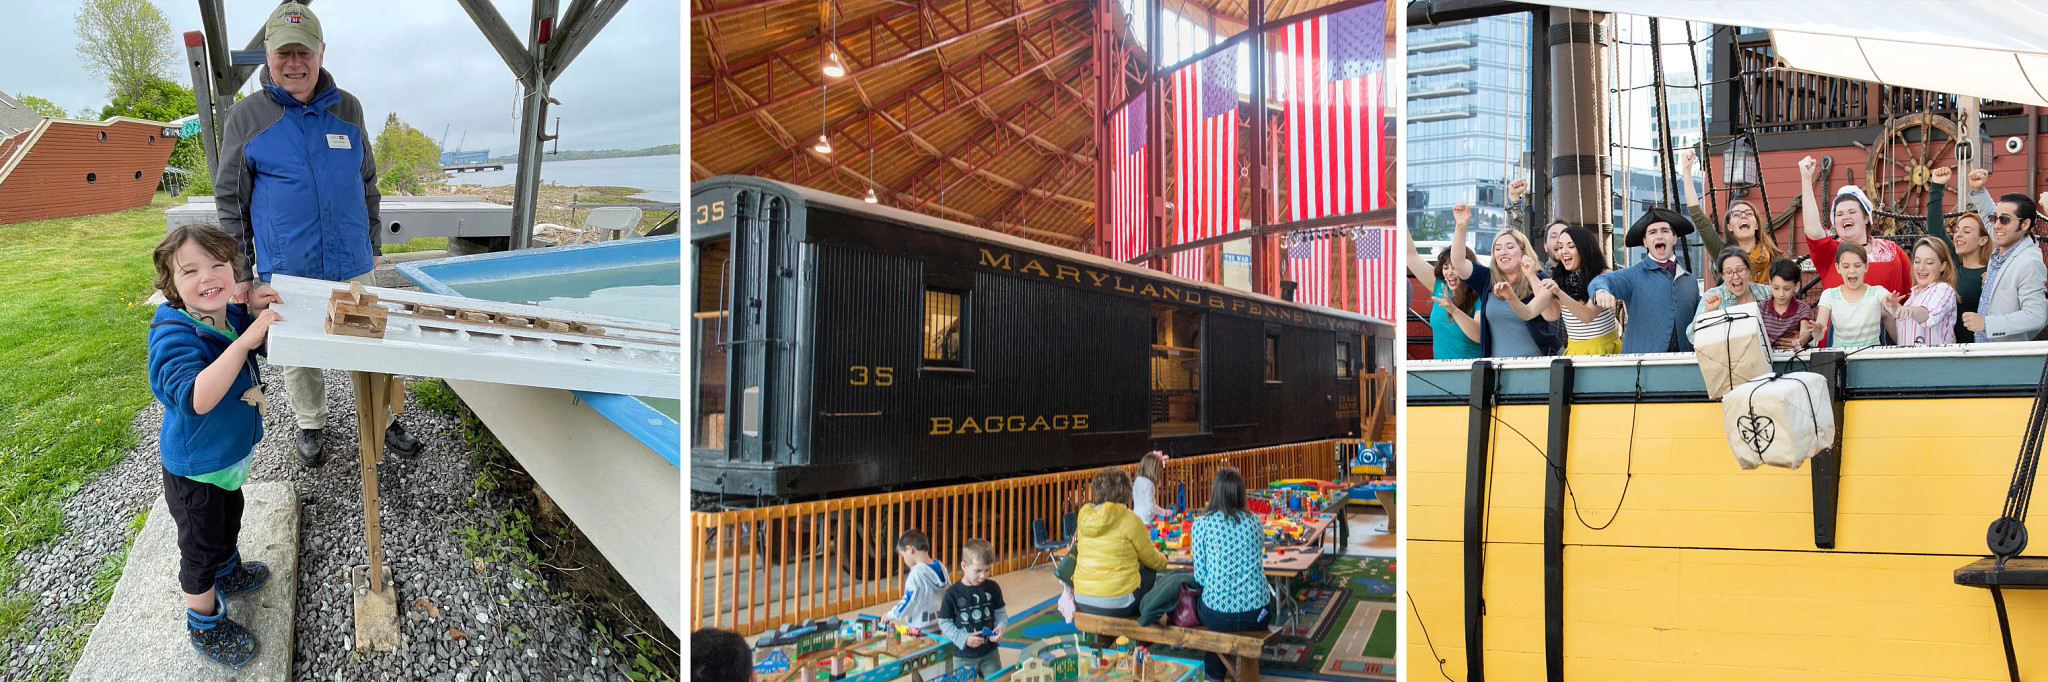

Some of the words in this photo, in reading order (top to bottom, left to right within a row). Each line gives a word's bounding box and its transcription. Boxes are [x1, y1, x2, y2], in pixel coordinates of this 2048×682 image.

[696, 200, 724, 224] 35
[978, 248, 1201, 305] MARYLAND
[1208, 295, 1225, 310] &
[1231, 299, 1367, 333] PENNSYLVANIA
[850, 366, 893, 386] 35
[929, 414, 1089, 435] BAGGAGE
